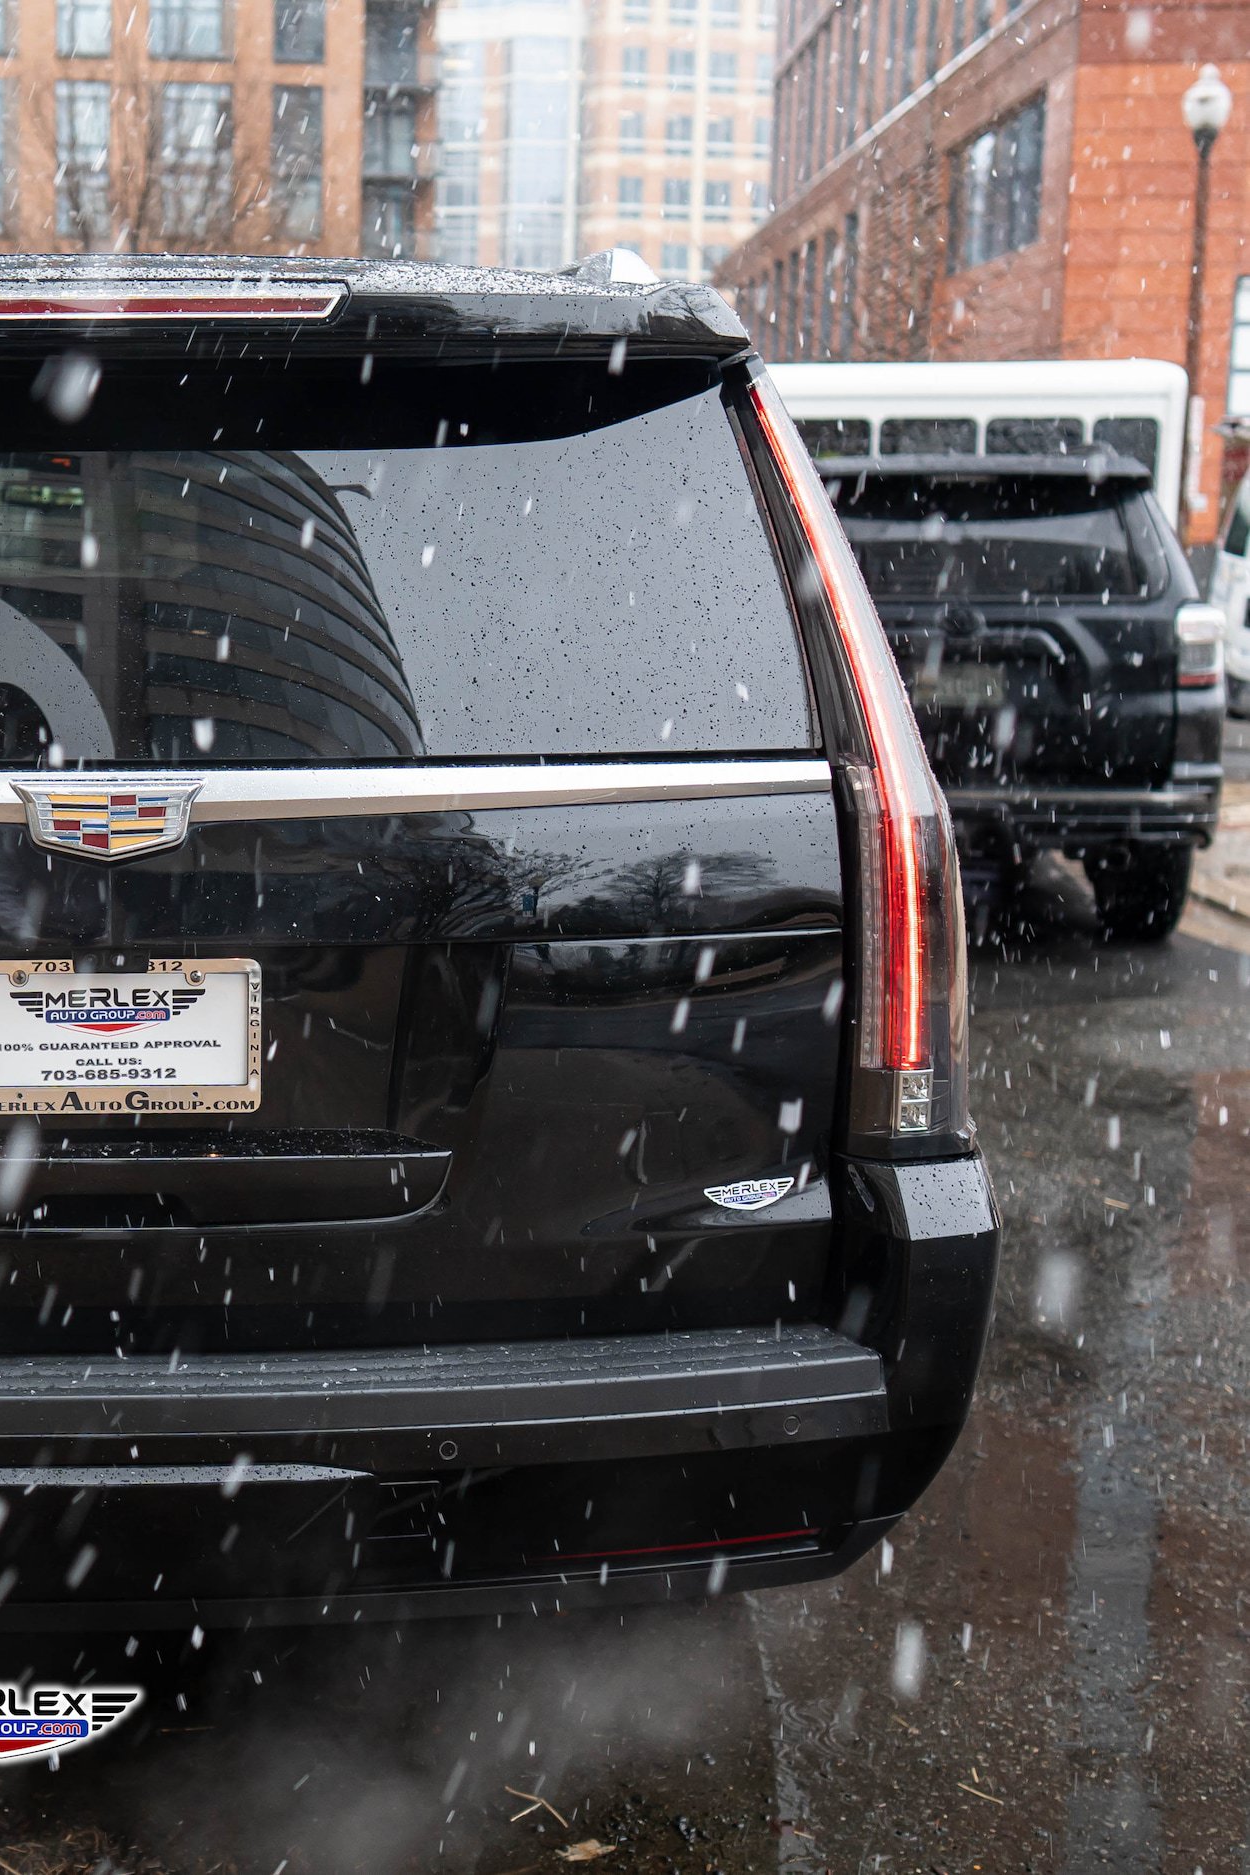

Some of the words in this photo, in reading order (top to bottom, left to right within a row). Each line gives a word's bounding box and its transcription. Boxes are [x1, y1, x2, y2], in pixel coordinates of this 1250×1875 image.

[31, 961, 71, 972] 703
[45, 988, 170, 1008] MERLEX
[50, 1011, 87, 1020] AUTO
[249, 982, 260, 1076] VIRGINIA
[39, 1041, 139, 1051] GUARANTEED
[143, 1039, 221, 1049] APPROVAL
[75, 1058, 113, 1066] CALL
[118, 1057, 142, 1066] US:
[41, 1068, 177, 1081] 703-685-9312
[722, 1182, 776, 1197] MERLEX
